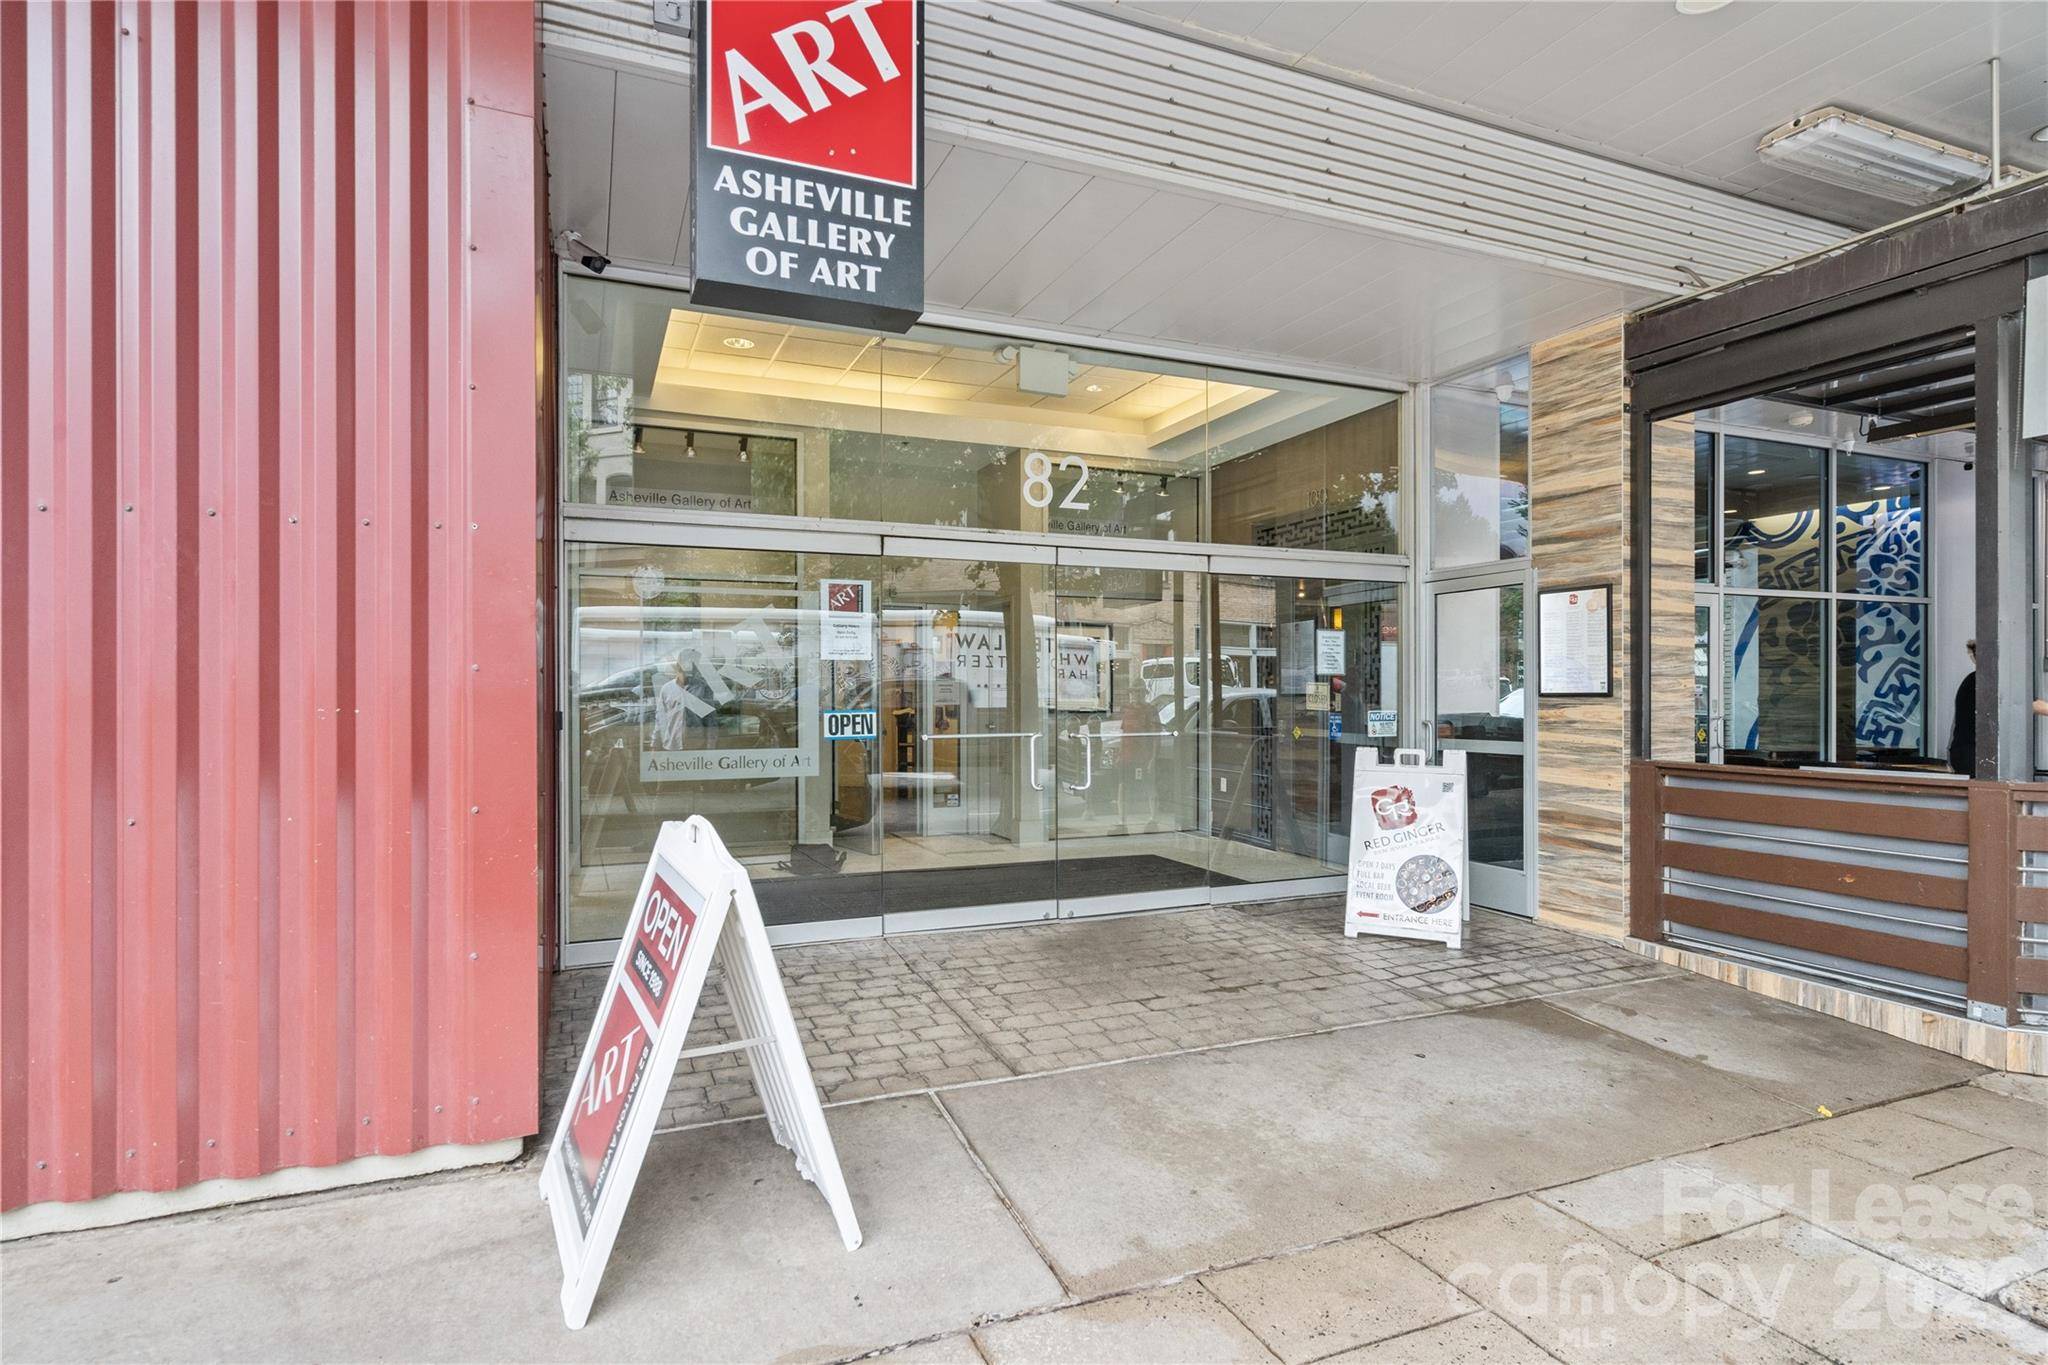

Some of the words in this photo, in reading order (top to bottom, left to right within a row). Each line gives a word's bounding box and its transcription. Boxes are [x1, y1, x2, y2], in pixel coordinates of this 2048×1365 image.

[724, 0, 901, 145] ART
[713, 164, 912, 227] ASHEVILLE
[729, 206, 896, 260] GALLERY
[745, 246, 799, 279] OF
[810, 257, 882, 293] ART
[609, 490, 667, 504] Asheville
[671, 493, 715, 509] Gallery
[719, 496, 731, 508] of
[734, 498, 752, 509] Art
[1023, 452, 1090, 510] 82
[1067, 520, 1100, 534] Gallery
[1103, 523, 1112, 533] of
[1113, 524, 1127, 535] Art
[829, 585, 856, 611] ART
[828, 714, 874, 736] OPEN
[1369, 712, 1396, 722] NOTICE
[648, 756, 713, 772] Asheville
[718, 755, 768, 772] Gallery
[773, 754, 786, 768] of
[790, 753, 811, 767] Art
[1364, 835, 1391, 851] RED
[1393, 821, 1446, 844] GINGER
[642, 889, 689, 971] OPEN
[1383, 912, 1429, 925] ENTRANCE
[1430, 917, 1453, 928] HERE
[574, 1025, 642, 1126] ART
[638, 1046, 649, 1070] 82
[616, 1073, 639, 1133] PATTON
[592, 1133, 616, 1200] AVENUE
